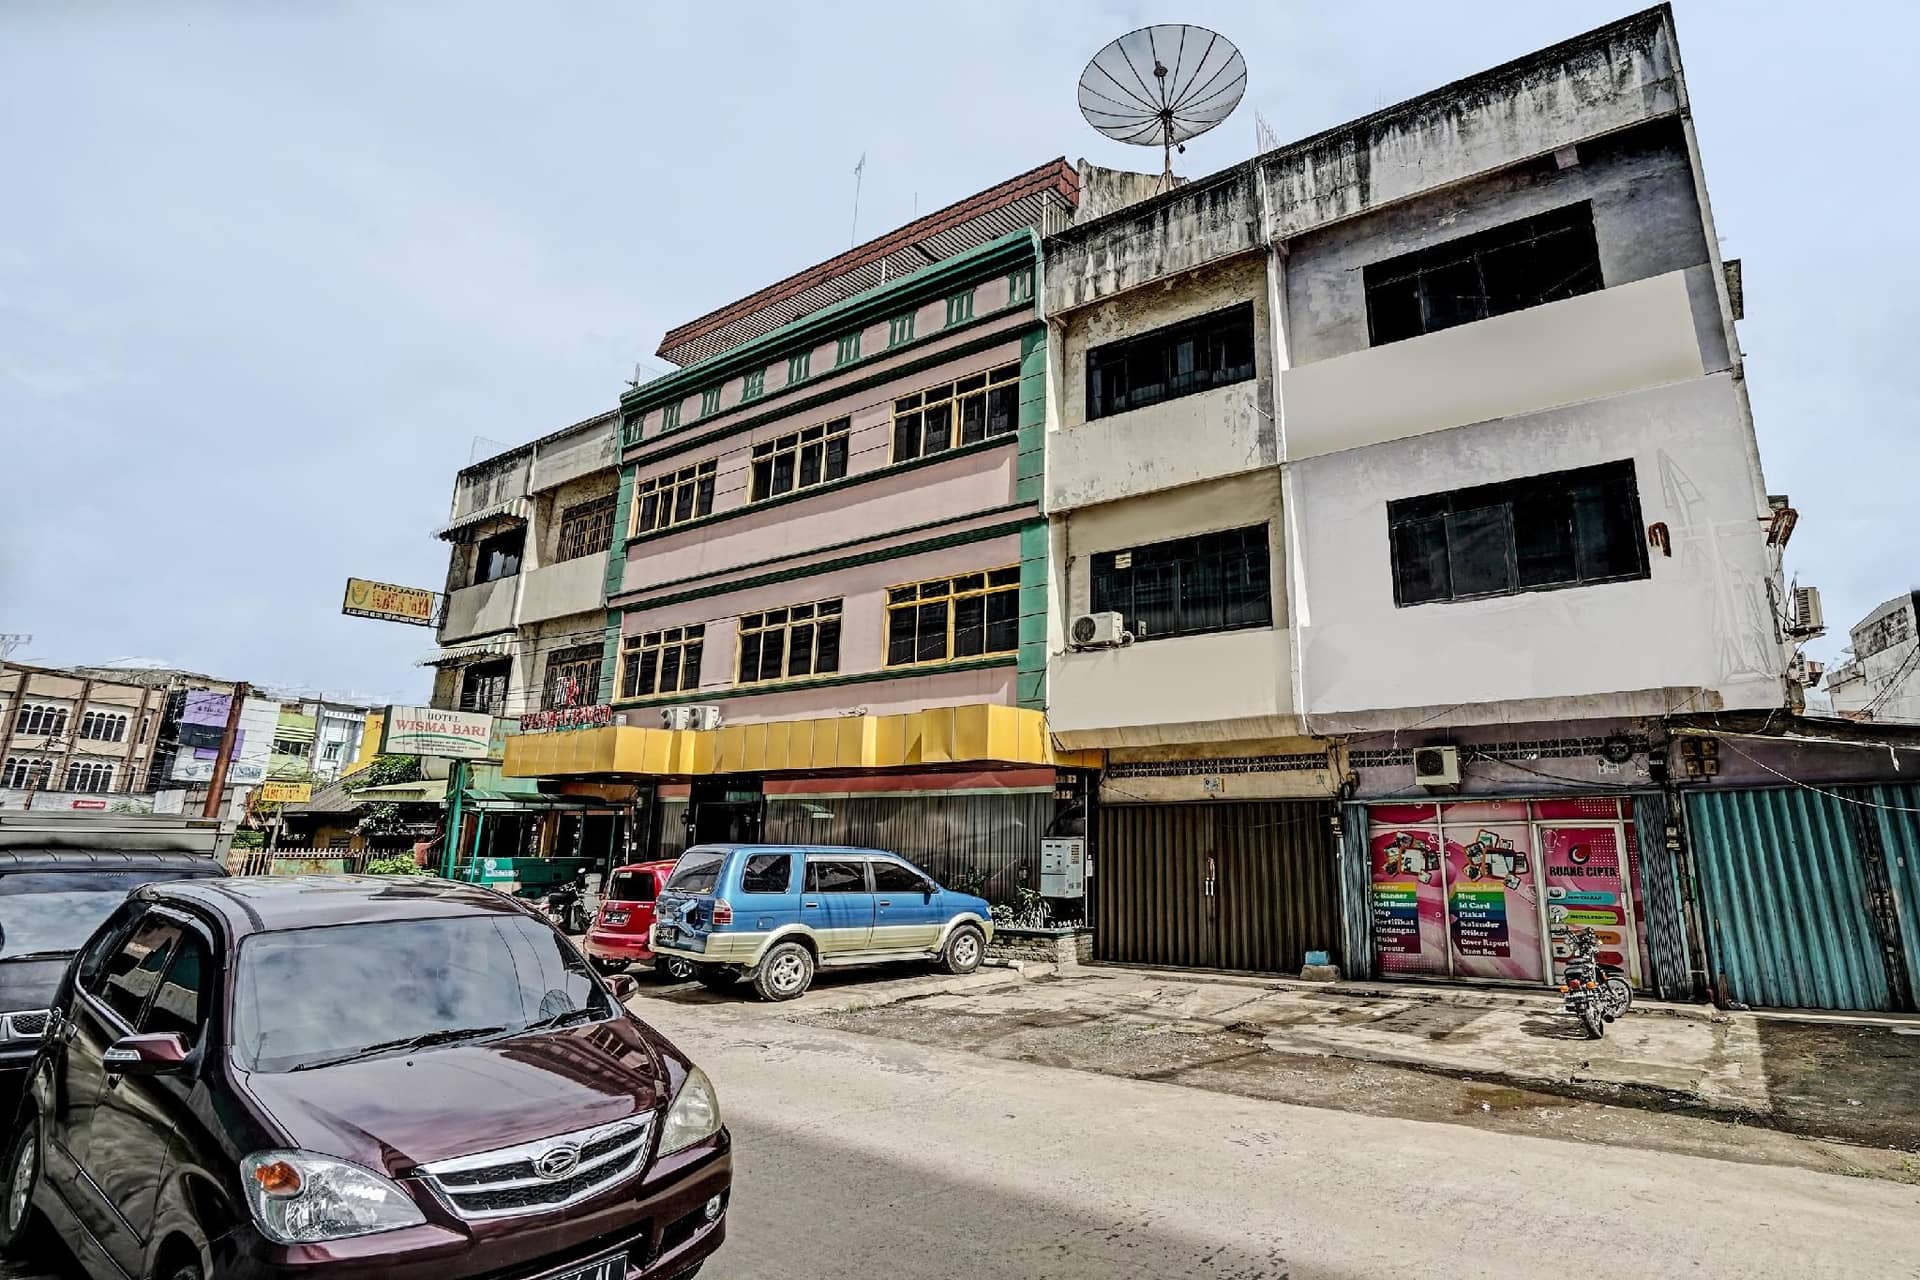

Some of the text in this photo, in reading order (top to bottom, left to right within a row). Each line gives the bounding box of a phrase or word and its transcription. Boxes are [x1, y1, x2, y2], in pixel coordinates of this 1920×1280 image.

[373, 584, 428, 597] PENJAHIT
[427, 712, 460, 723] HOTEL
[396, 720, 448, 734] WISMA
[452, 724, 487, 736] BARI
[1549, 866, 1617, 877] RUANG CIPTA
[1457, 893, 1477, 901] Mug
[1374, 909, 1391, 917] Map
[1375, 926, 1416, 935] Undangan
[1461, 938, 1482, 946] Cover
[1482, 948, 1497, 956] Box
